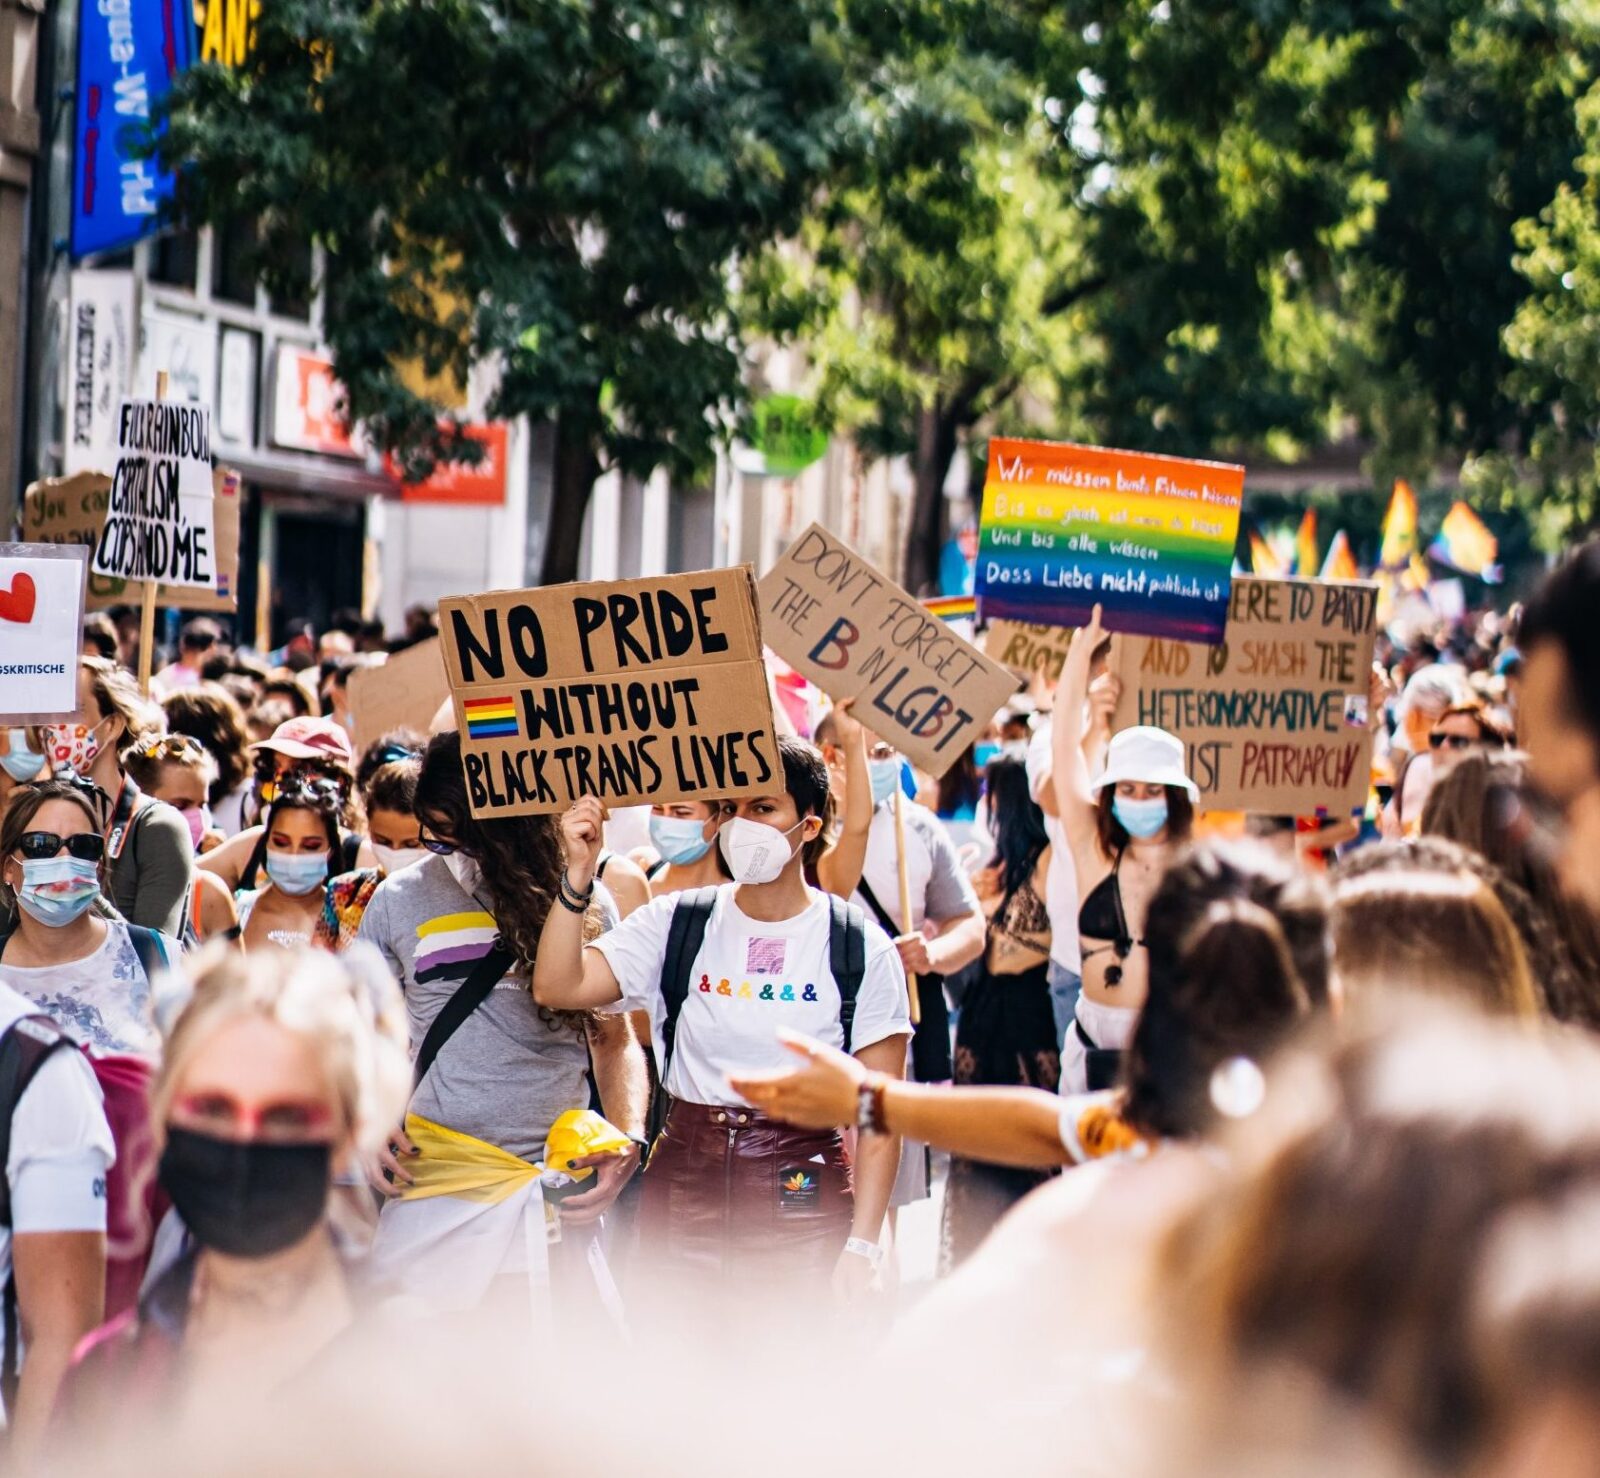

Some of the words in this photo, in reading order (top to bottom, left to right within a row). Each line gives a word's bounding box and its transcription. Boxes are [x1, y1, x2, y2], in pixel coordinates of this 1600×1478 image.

[997, 454, 1034, 483] Wir
[1046, 466, 1111, 489] müssen
[170, 526, 211, 582] ME
[991, 528, 1022, 546] Und
[1031, 530, 1055, 548] bis
[1068, 532, 1098, 554] alle
[1110, 539, 1159, 561] wissen
[771, 577, 822, 637] THE
[791, 530, 883, 607] DON'T
[878, 598, 989, 689] FORGET
[1043, 563, 1093, 590] Liebe
[1101, 567, 1147, 594] nicht
[1149, 573, 1200, 598] politisch
[1204, 583, 1220, 602] ist
[1229, 581, 1282, 623] ERE
[1287, 583, 1315, 624] TO
[451, 605, 548, 682] NO
[573, 587, 729, 672] PRIDE
[807, 616, 860, 671] B
[1140, 637, 1191, 677] AND
[1237, 640, 1307, 679] SMASH
[1315, 639, 1358, 684] THE
[857, 646, 896, 685] IN
[520, 678, 700, 740] WITHOUT
[872, 666, 974, 753] LGBT
[464, 749, 557, 809] BLACK
[554, 735, 662, 800] TRANS
[672, 730, 772, 791] LIVES
[1189, 741, 1232, 793] IST
